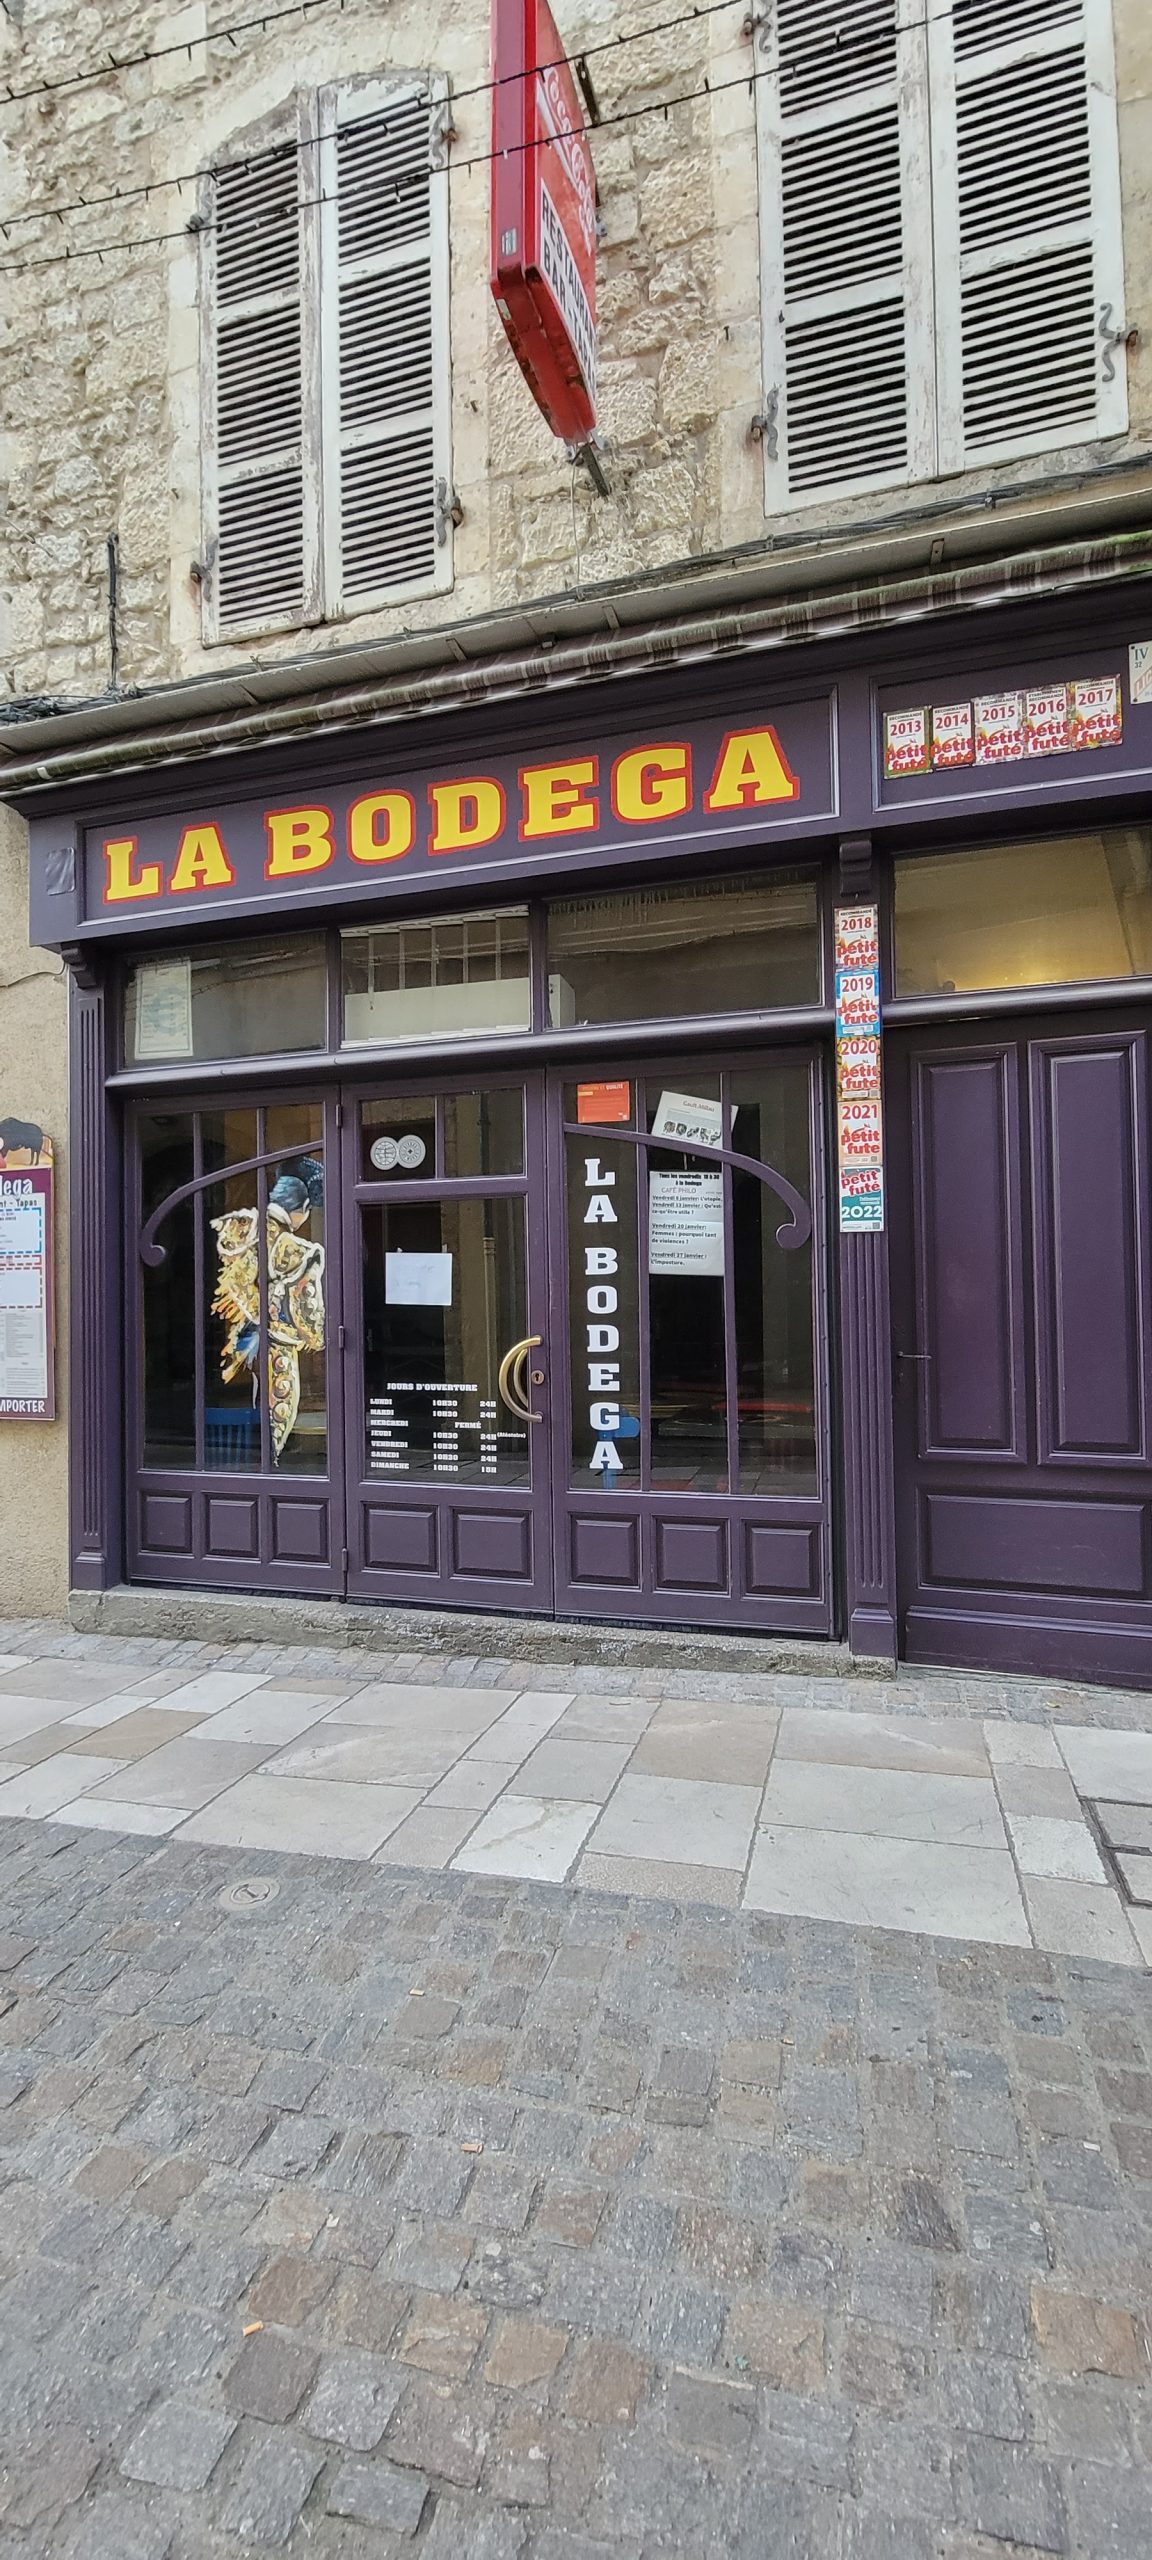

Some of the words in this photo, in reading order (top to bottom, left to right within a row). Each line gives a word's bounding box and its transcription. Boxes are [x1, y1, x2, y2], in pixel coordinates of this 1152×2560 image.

[542, 190, 597, 360] RESTAURAN
[544, 237, 566, 312] BAR
[1135, 647, 1148, 660] IV
[1078, 689, 1113, 706] 2017
[982, 705, 1015, 721] 2015
[1028, 699, 1065, 717] 2016
[890, 720, 921, 736] 2013
[935, 713, 968, 729] 2014
[1073, 713, 1120, 736] petit
[1023, 721, 1069, 742] petit
[931, 738, 973, 757] petit
[977, 730, 1021, 750] petit
[886, 744, 927, 763] petit
[103, 822, 236, 904] LA
[264, 725, 799, 881] BODEGA
[841, 917, 872, 931] 2018
[837, 940, 877, 958] petit
[842, 977, 873, 992] 2019
[841, 1040, 877, 1055] 2020
[840, 1065, 878, 1080] petit
[842, 1104, 877, 1120] 2021
[841, 1129, 880, 1145] petit
[841, 1170, 877, 1189] petit
[584, 1158, 618, 1222] LA
[849, 1181, 880, 1196] futé
[16, 1198, 37, 1208] Tapas
[842, 1205, 882, 1218] 2022
[584, 1247, 624, 1469] BODEGA
[416, 1383, 478, 1392] D'OUVERTURE
[454, 1421, 481, 1429] FERMÉ
[371, 1462, 410, 1470] DIMANCHE
